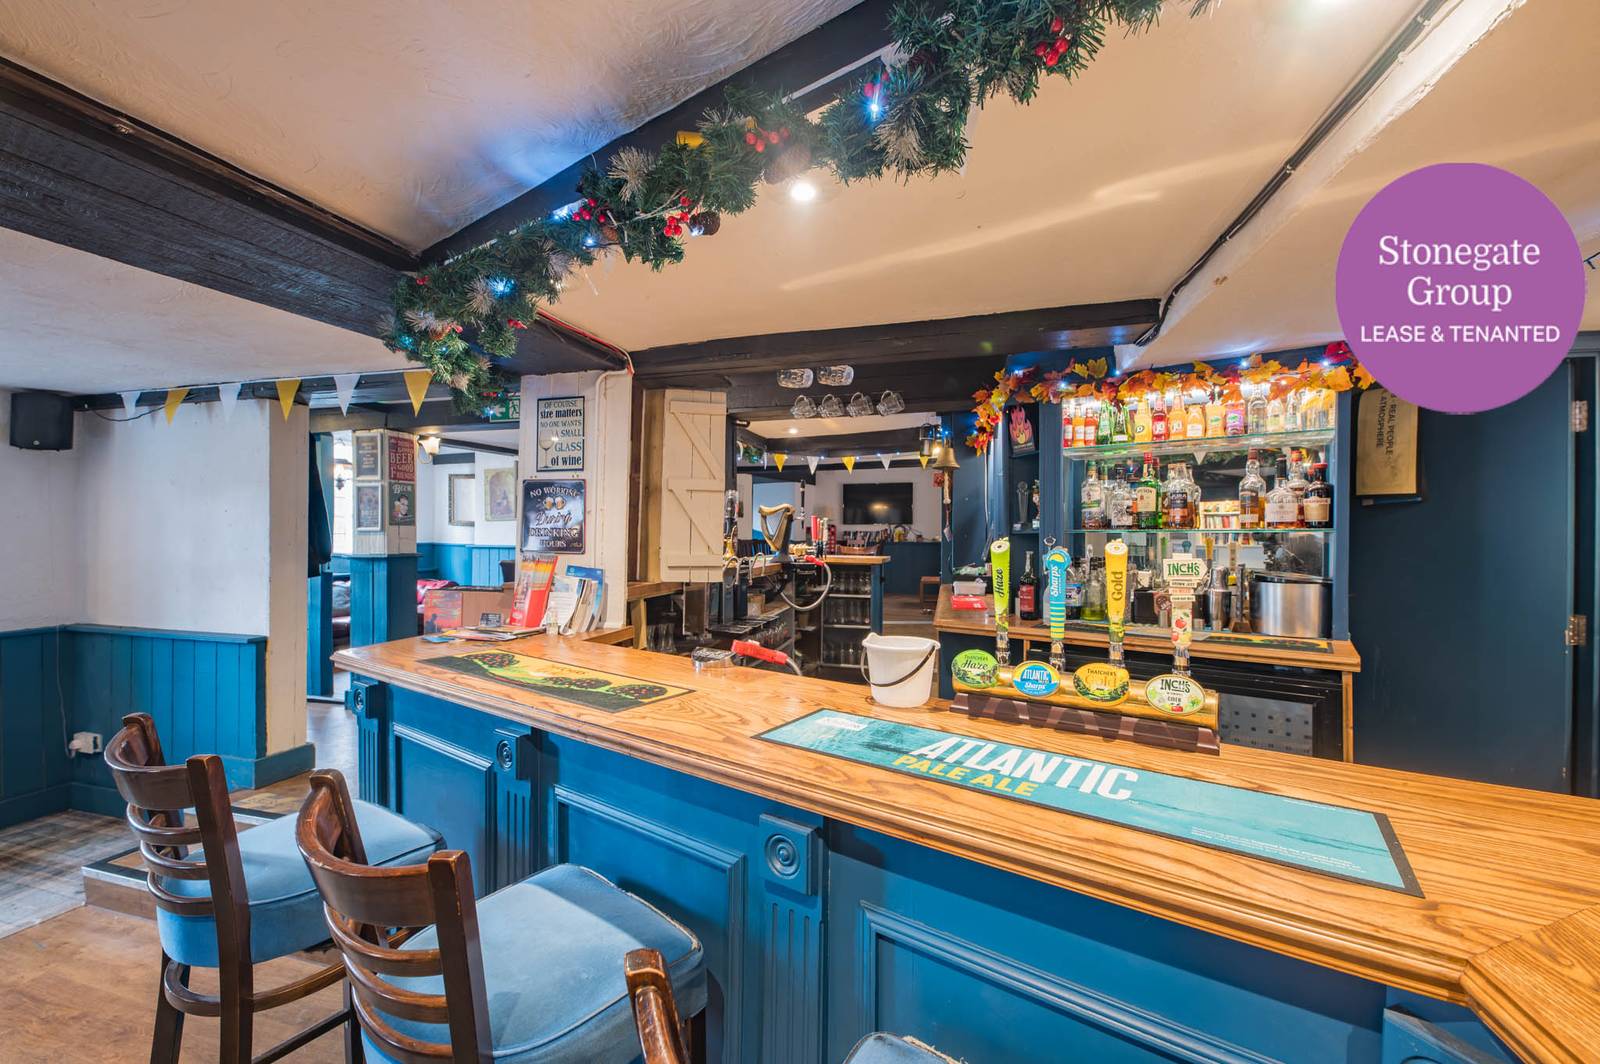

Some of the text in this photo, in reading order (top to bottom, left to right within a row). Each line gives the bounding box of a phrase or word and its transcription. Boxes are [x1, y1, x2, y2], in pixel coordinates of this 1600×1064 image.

[544, 399, 577, 409] OF COURSE
[540, 408, 582, 419] size matters
[1387, 403, 1397, 423] REAL
[1376, 396, 1387, 448] ATMOSPHERE
[560, 429, 582, 438] SMALL
[1385, 424, 1395, 456] PEOPLE
[554, 441, 582, 452] GLASS
[390, 452, 413, 464] BEER
[551, 455, 582, 466] of wine
[397, 463, 414, 472] GOOD
[530, 488, 542, 498] NO
[535, 511, 573, 526] During
[528, 527, 579, 538] DRINKING
[540, 539, 567, 548] HOURS
[994, 567, 1005, 598] Haze
[1112, 571, 1123, 601] Gold
[961, 659, 988, 671] Haze
[1022, 668, 1049, 682] ATLANTIC
[907, 736, 1139, 801] ATLANTIC
[892, 754, 1040, 797] PALE ALE
